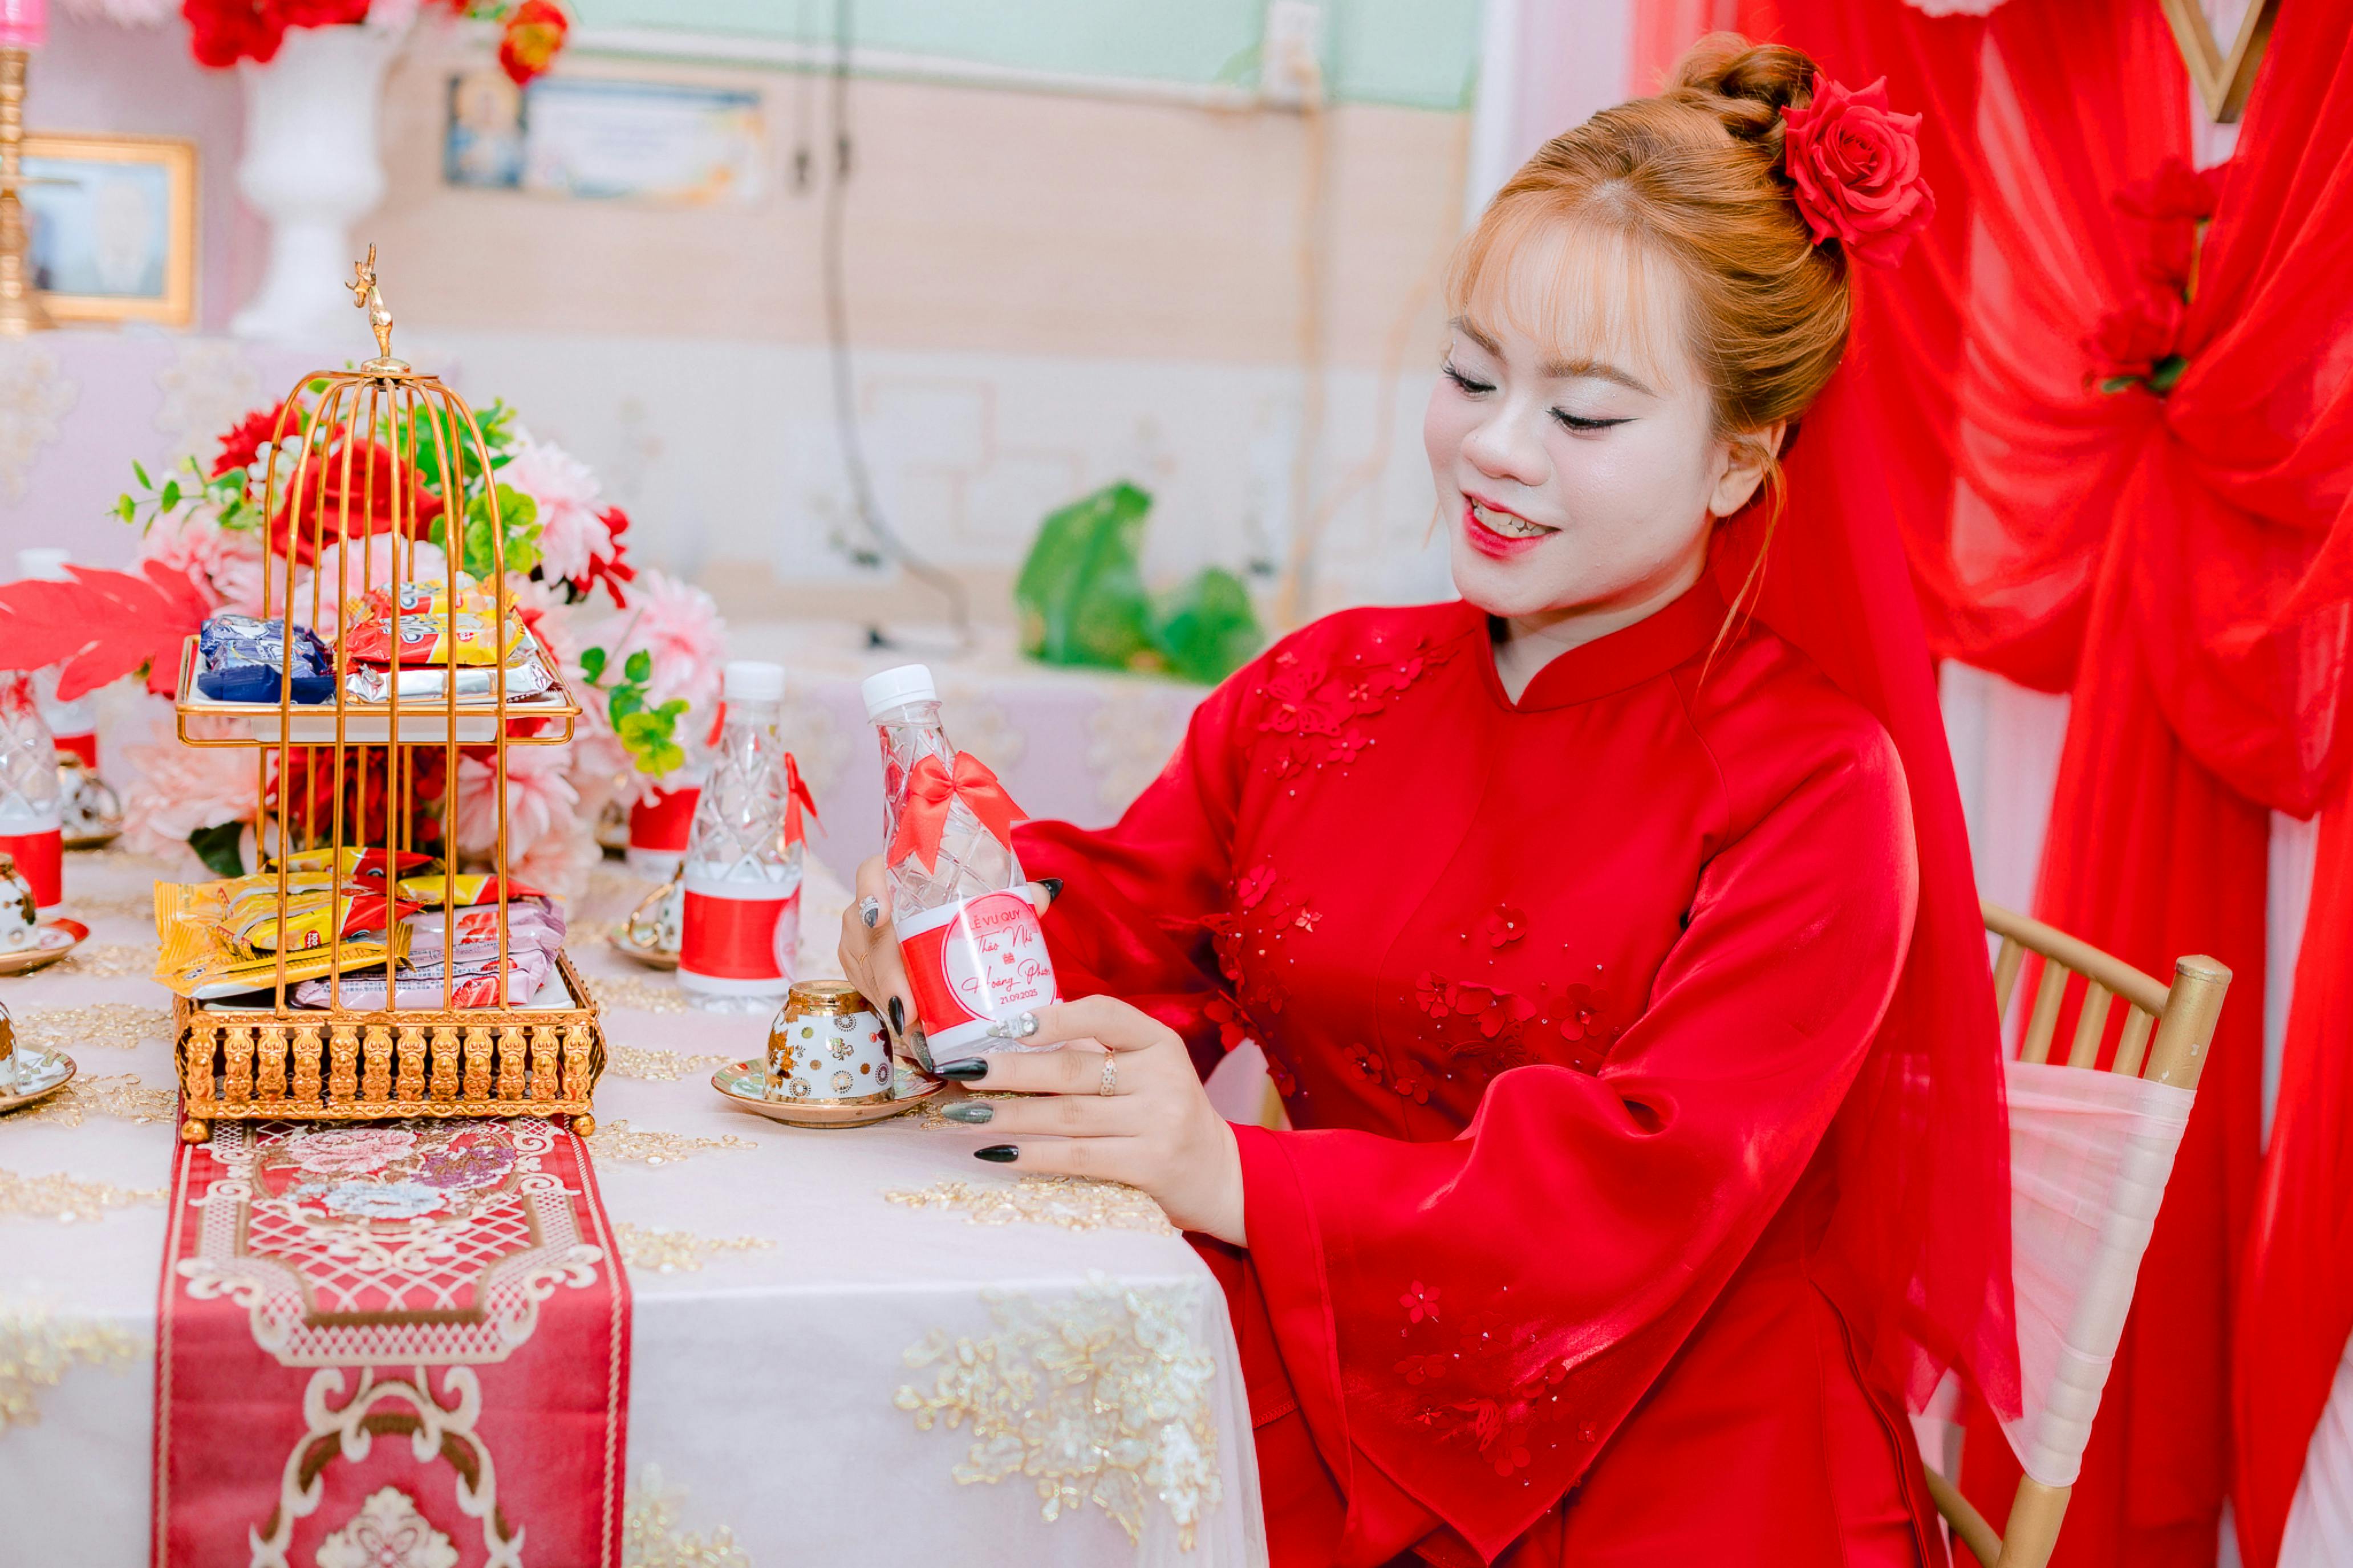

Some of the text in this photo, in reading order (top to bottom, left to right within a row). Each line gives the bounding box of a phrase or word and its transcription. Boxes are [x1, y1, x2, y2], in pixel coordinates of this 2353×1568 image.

[982, 915, 998, 925] VU
[1000, 909, 1020, 921] QUY
[1000, 989, 1038, 1004] 21.09.2025
